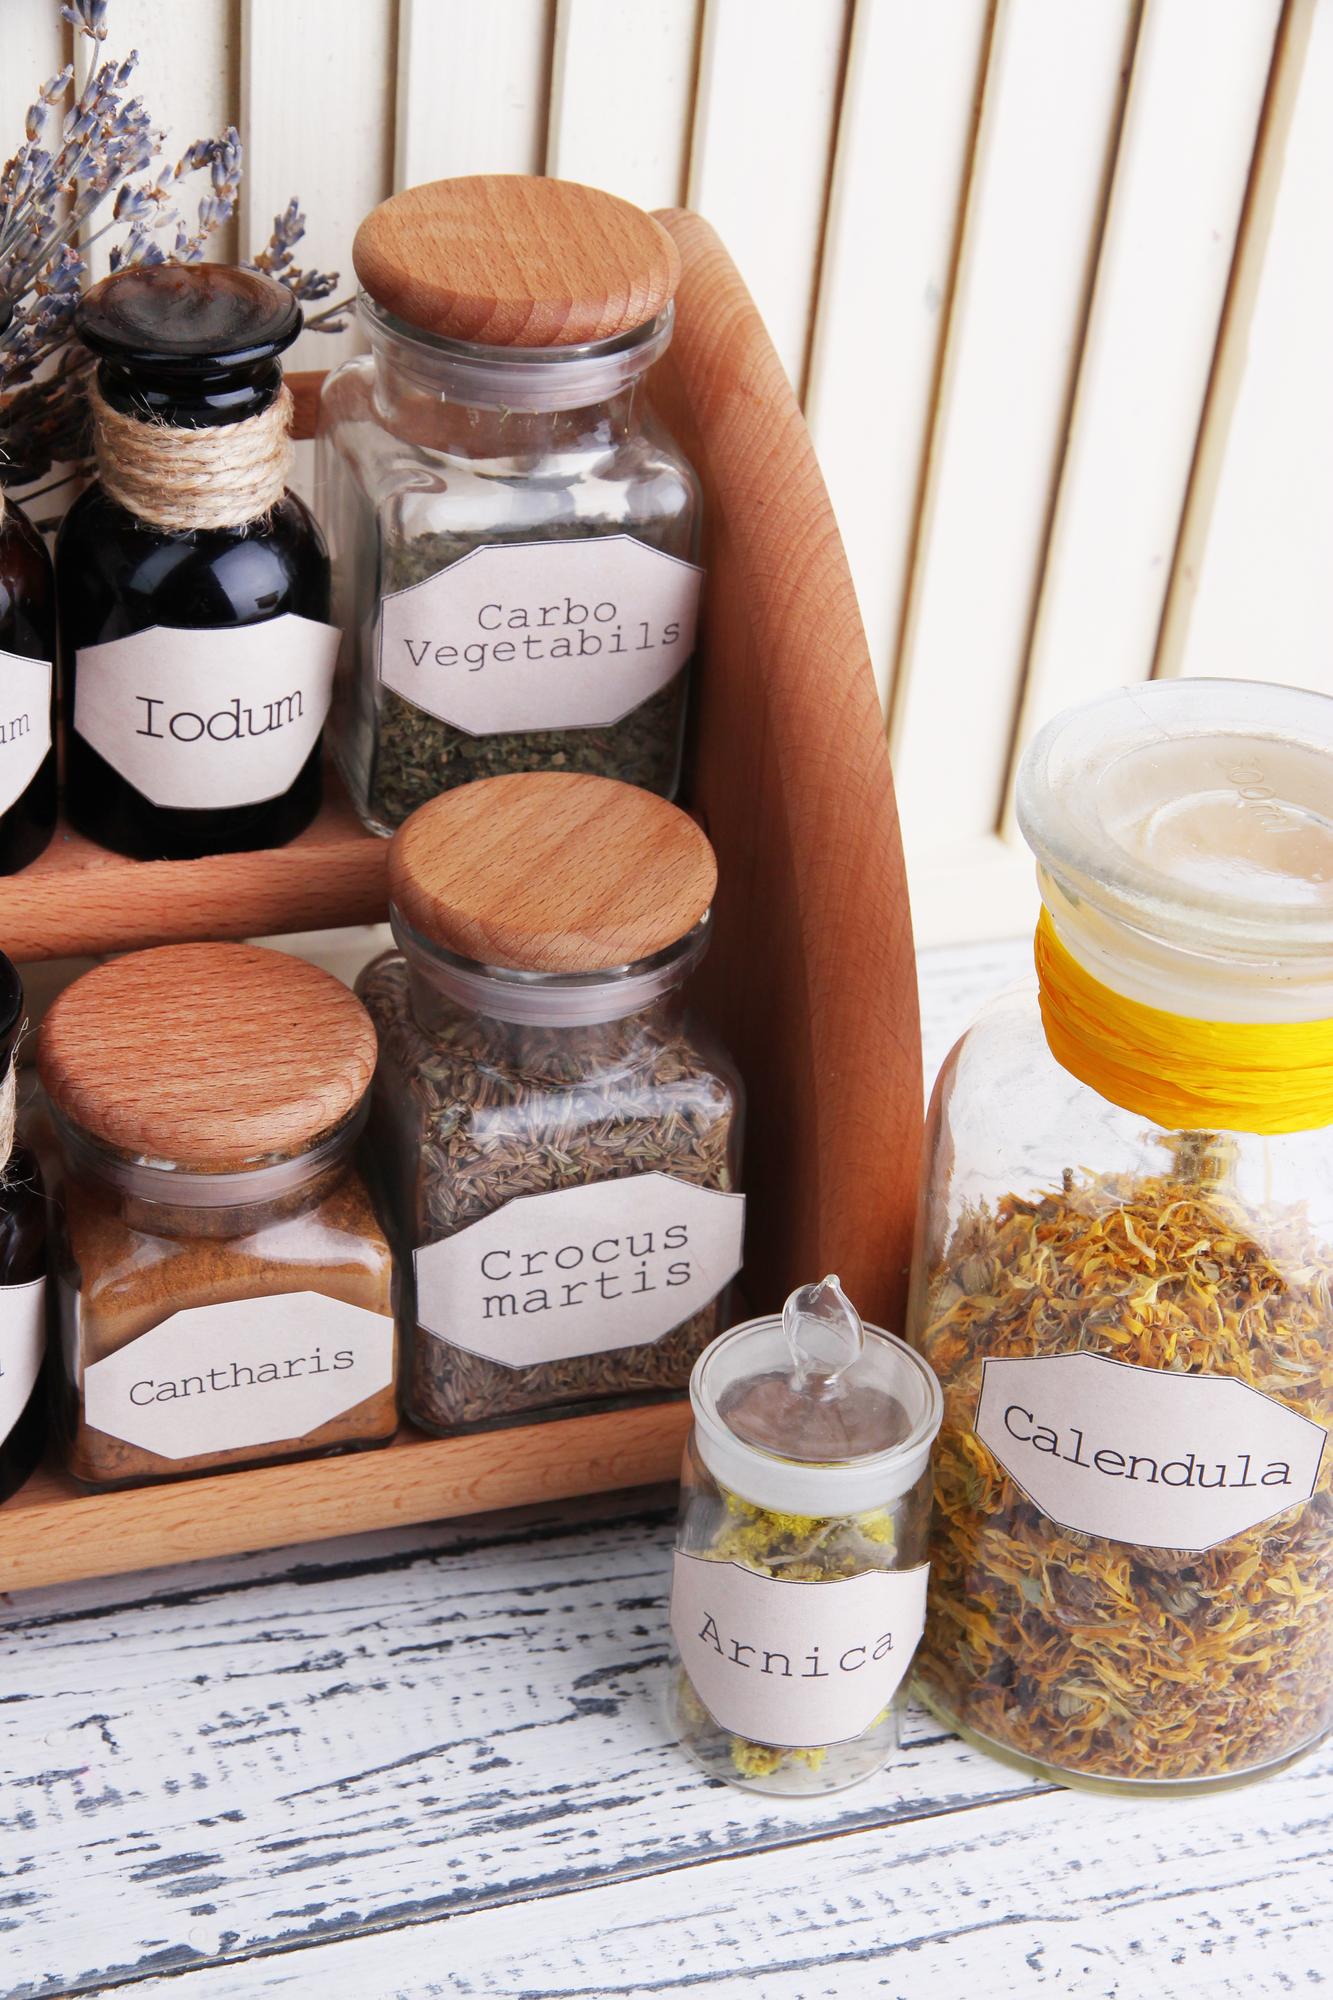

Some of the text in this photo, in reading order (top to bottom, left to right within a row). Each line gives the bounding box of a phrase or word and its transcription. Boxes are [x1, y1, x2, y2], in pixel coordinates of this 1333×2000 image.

[478, 597, 618, 630] Carbo
[404, 622, 680, 671] Vegetabils
[136, 690, 303, 742] Iodum
[480, 1224, 689, 1281] Crocus
[482, 1261, 691, 1319] martis
[129, 1347, 355, 1406] Cantharis
[1003, 1405, 1292, 1488] Calendula
[698, 1611, 894, 1677] Arnica
